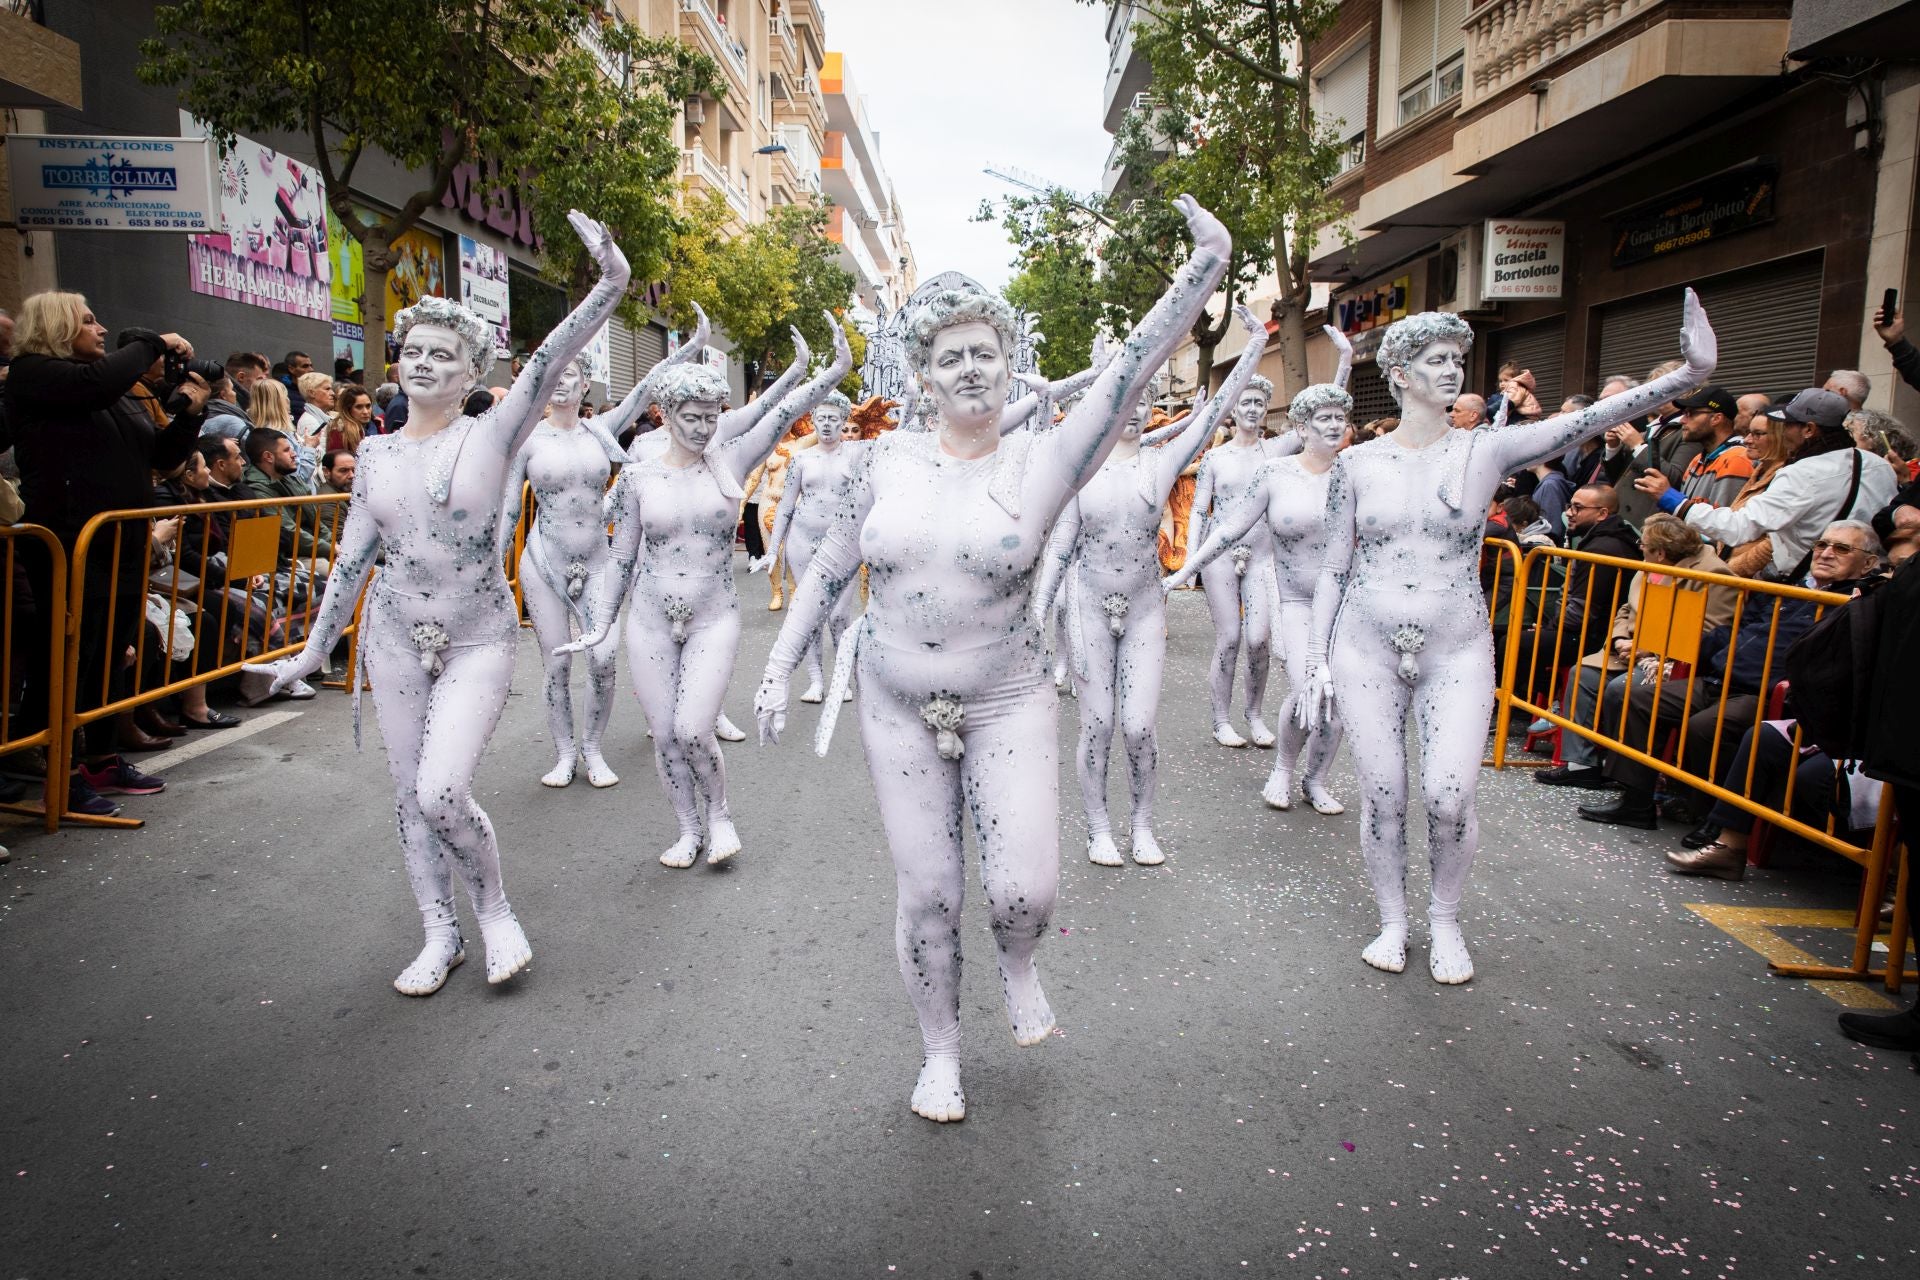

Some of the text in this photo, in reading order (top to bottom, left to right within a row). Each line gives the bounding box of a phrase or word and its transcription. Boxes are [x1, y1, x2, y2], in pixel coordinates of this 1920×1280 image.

[39, 139, 175, 152] INSTALACIONES
[44, 169, 175, 187] TORRECLIMA
[58, 200, 171, 209] AIRE ACONDICIONADO
[21, 207, 85, 216] CONDUCTOS
[125, 210, 202, 218] ELECTRICIDAD
[32, 216, 110, 226] 653 80 58 61
[128, 219, 205, 228] 653 80 58 62
[1630, 221, 1675, 246] Graciela
[1506, 238, 1549, 249] Unisex
[1653, 228, 1711, 253] 966705905
[1494, 249, 1547, 267] Graciela
[1494, 264, 1560, 283] Bortolotto
[200, 263, 326, 311] HERRAMIENTAS
[1501, 285, 1558, 293] 96 670 59 05
